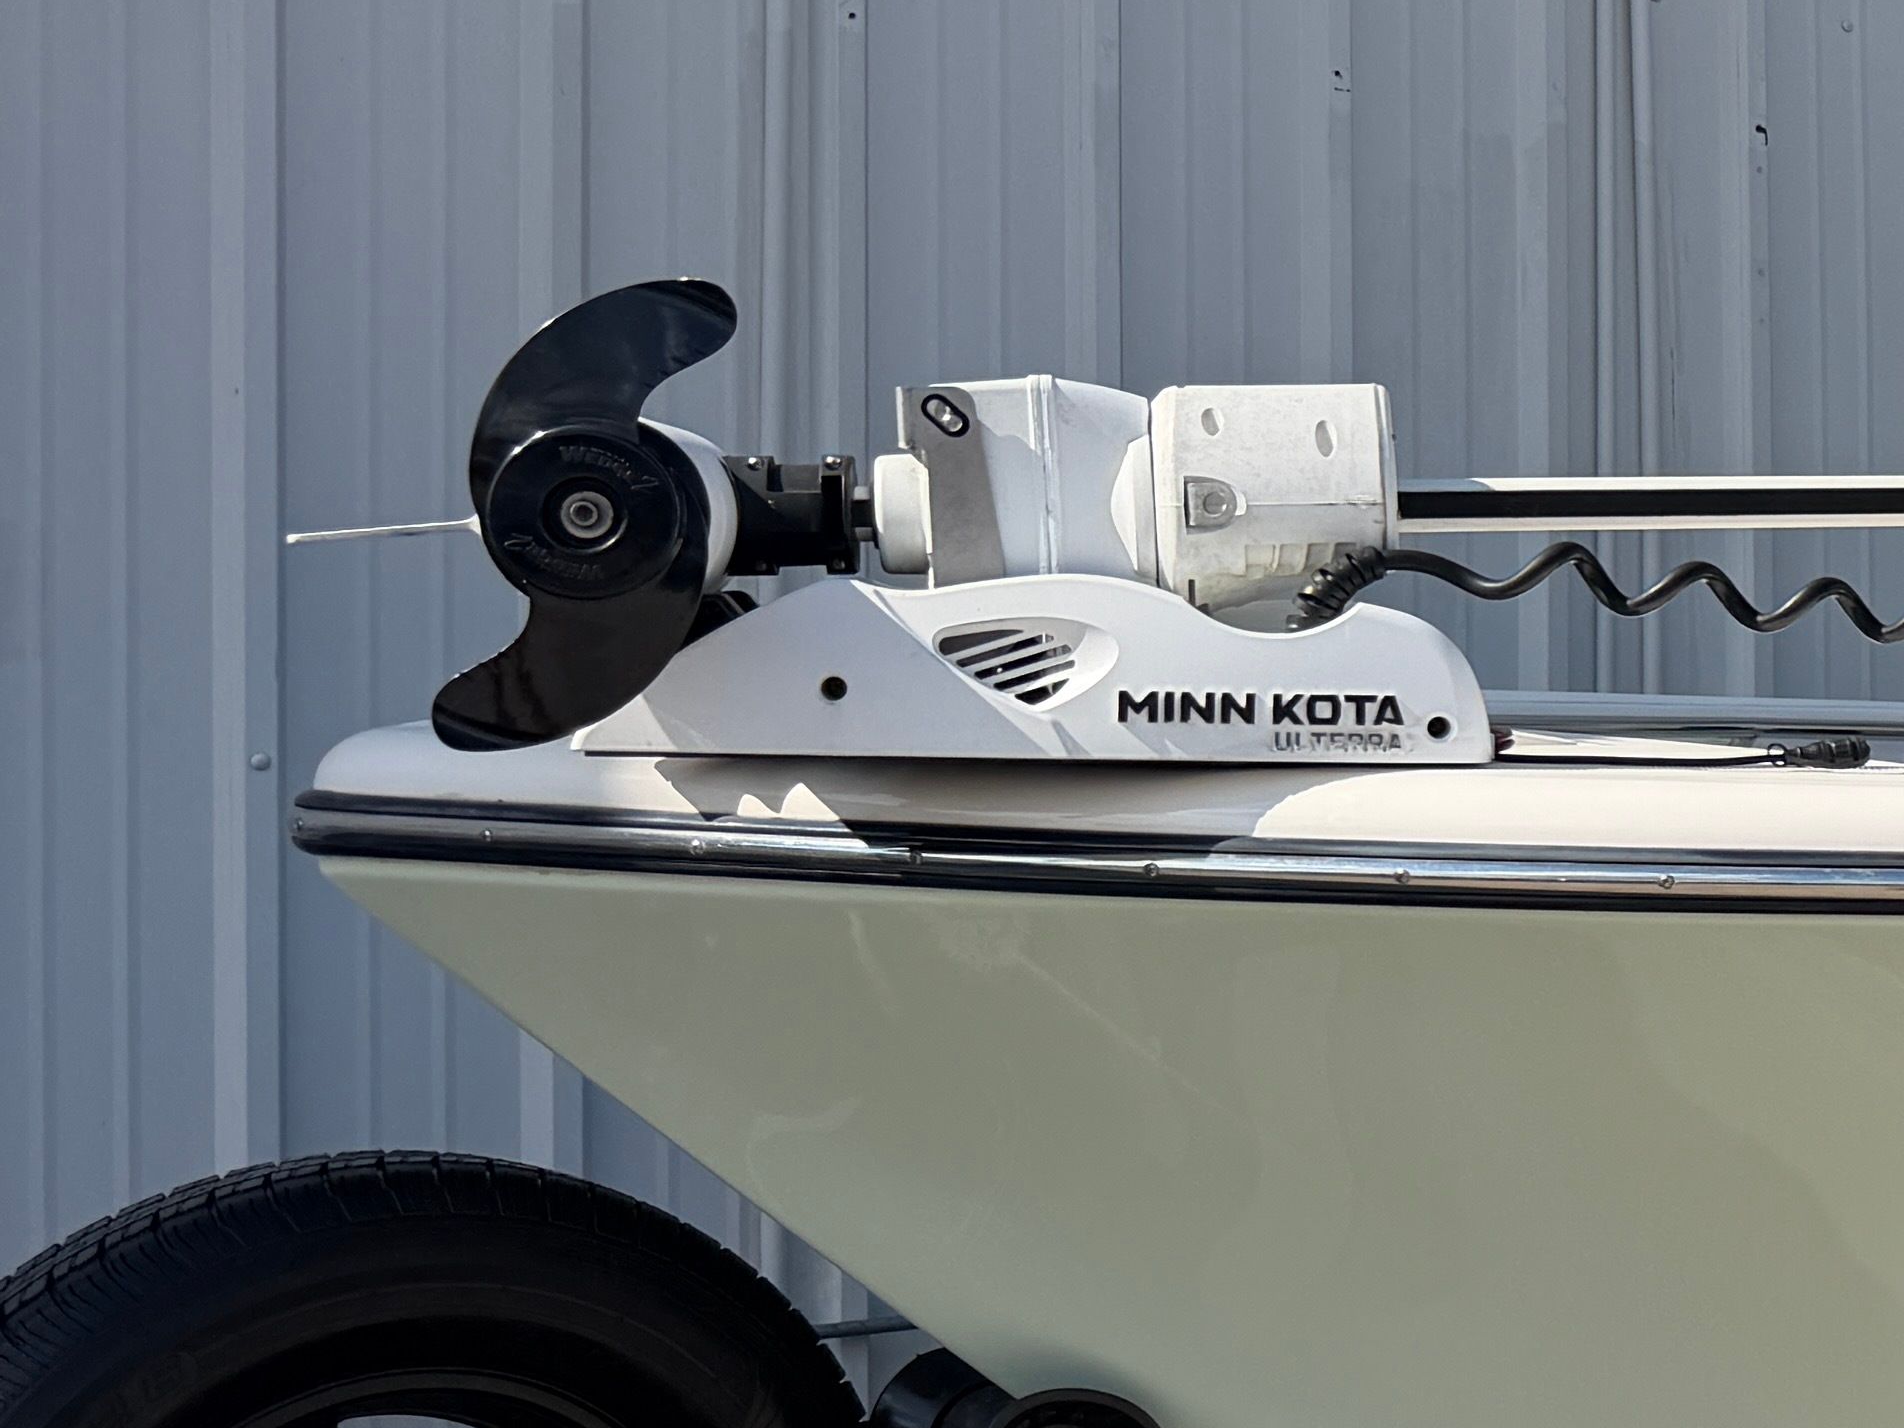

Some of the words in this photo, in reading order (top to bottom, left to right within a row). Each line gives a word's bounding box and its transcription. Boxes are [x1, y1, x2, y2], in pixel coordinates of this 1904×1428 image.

[1117, 690, 1256, 724] MINN
[1272, 693, 1404, 725] KOTA
[1274, 731, 1402, 752] ULTERRA
